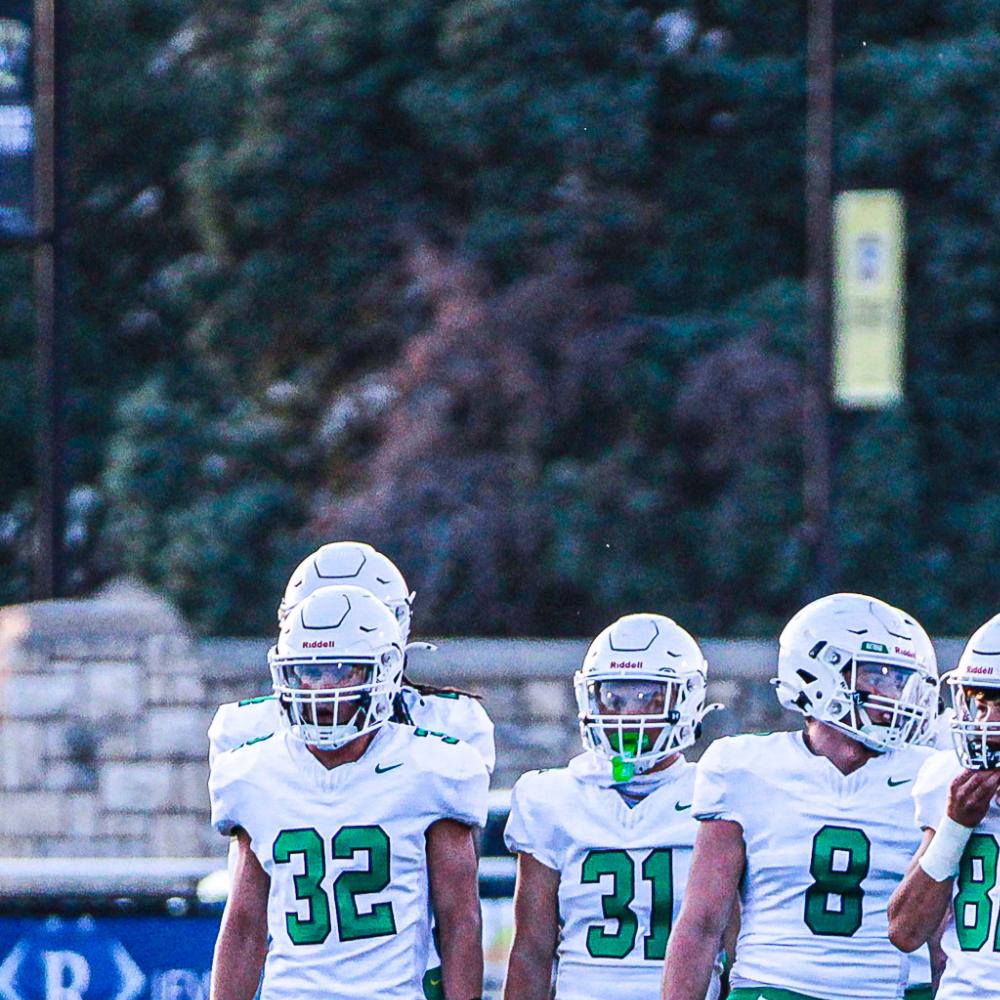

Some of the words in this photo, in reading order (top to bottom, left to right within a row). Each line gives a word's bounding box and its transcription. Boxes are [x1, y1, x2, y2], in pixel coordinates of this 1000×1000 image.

[302, 640, 335, 649] Riddell
[610, 660, 644, 669] Riddell
[272, 824, 398, 946] 32
[580, 849, 675, 962] 31
[803, 824, 871, 938] 8
